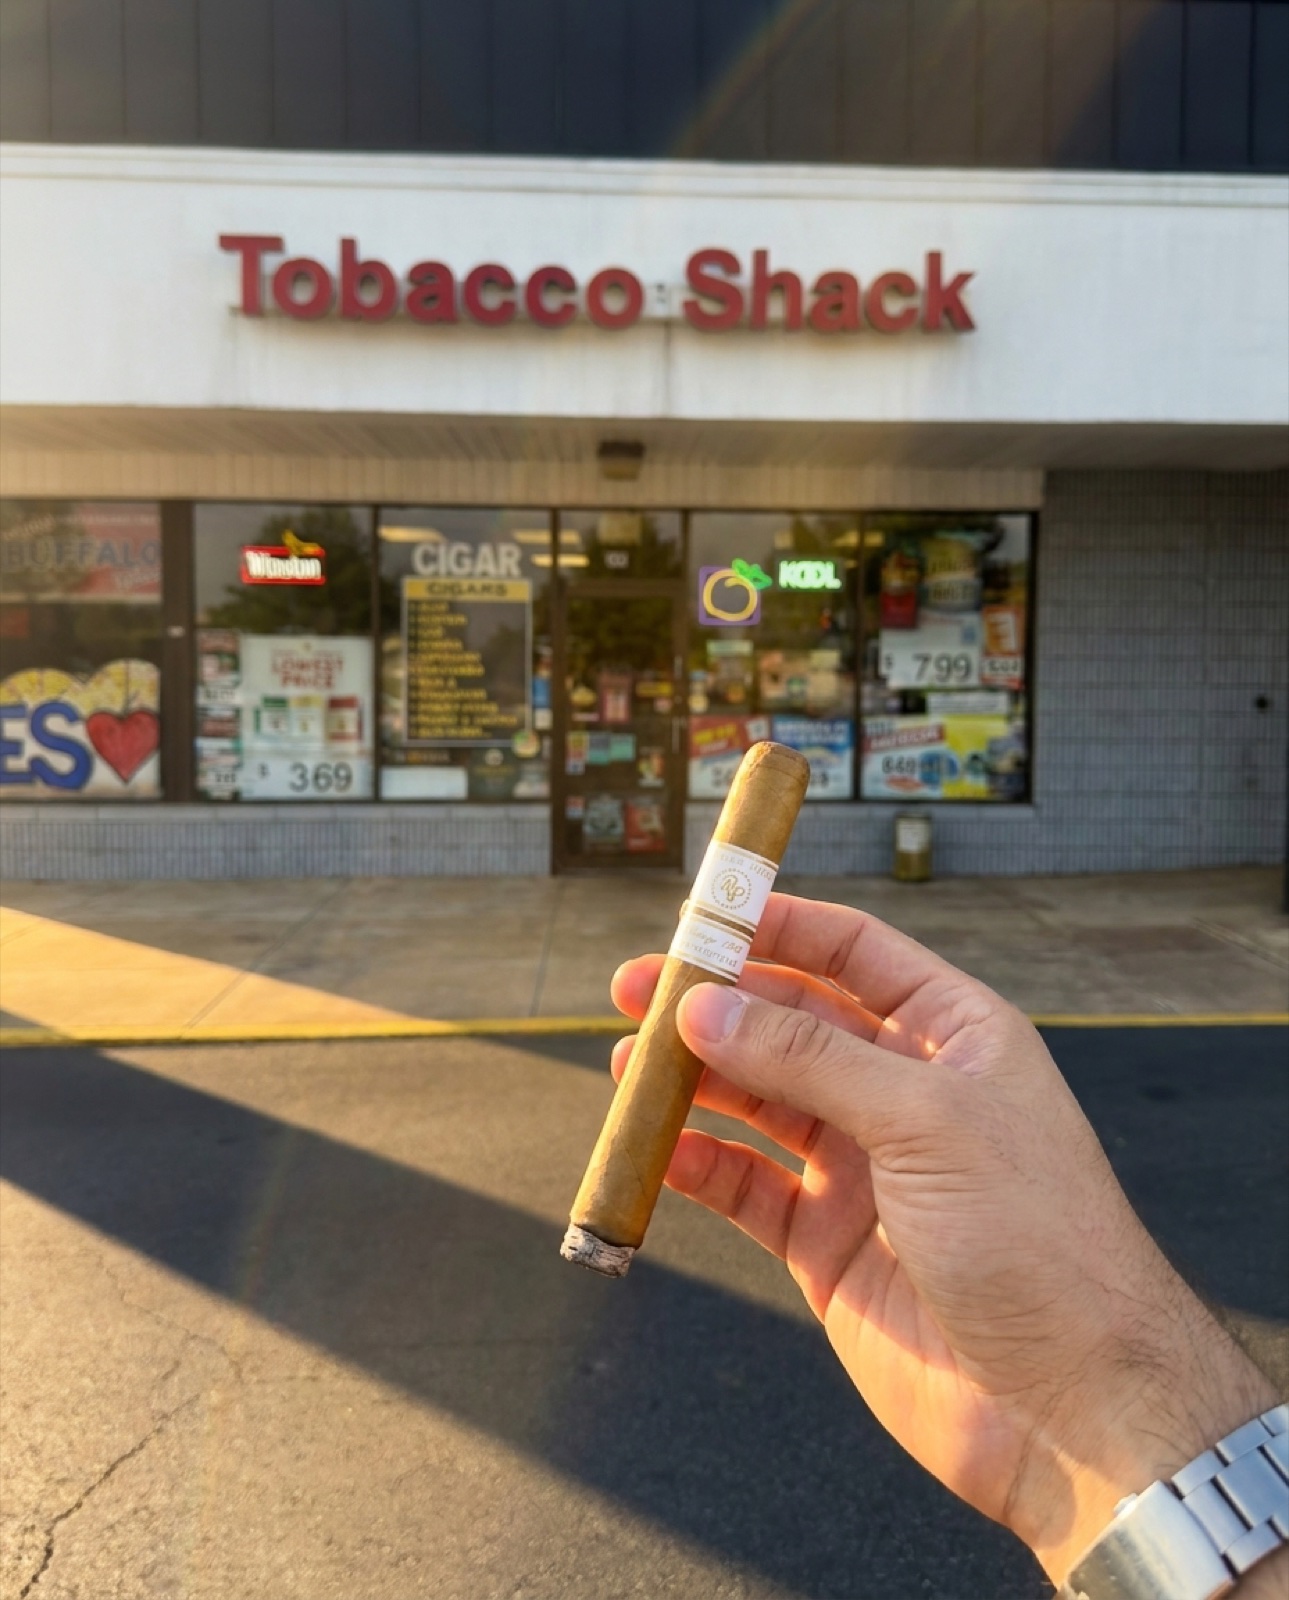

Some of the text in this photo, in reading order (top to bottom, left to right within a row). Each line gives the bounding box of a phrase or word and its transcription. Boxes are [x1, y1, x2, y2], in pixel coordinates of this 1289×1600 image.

[218, 234, 976, 333] Tobacco Shack
[412, 542, 522, 577] CIGAR
[778, 560, 842, 589] KOOL
[912, 653, 972, 683] 799
[289, 762, 353, 792] 369
